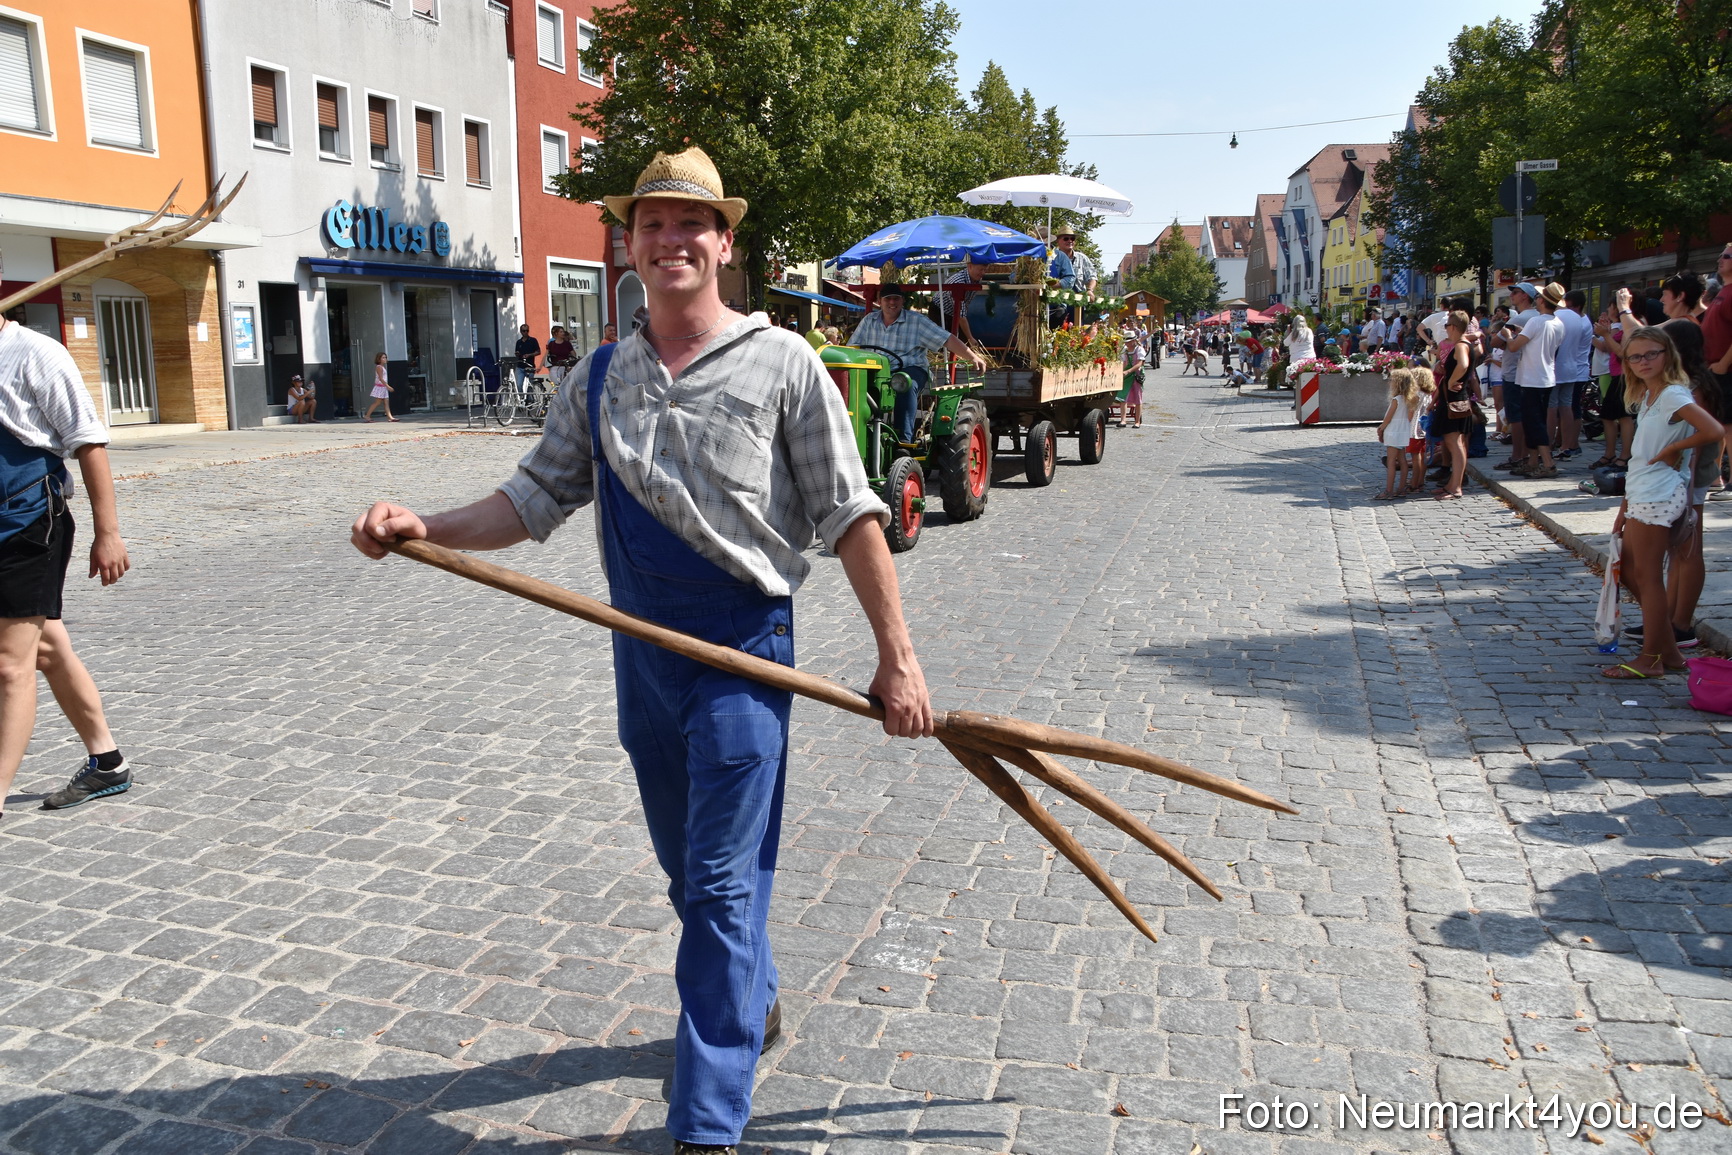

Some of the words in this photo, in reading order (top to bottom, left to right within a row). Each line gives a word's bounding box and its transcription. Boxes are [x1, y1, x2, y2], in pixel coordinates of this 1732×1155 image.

[325, 199, 427, 255] Eilles
[237, 280, 245, 289] 31
[558, 273, 590, 290] fielmann
[72, 292, 82, 302] 30
